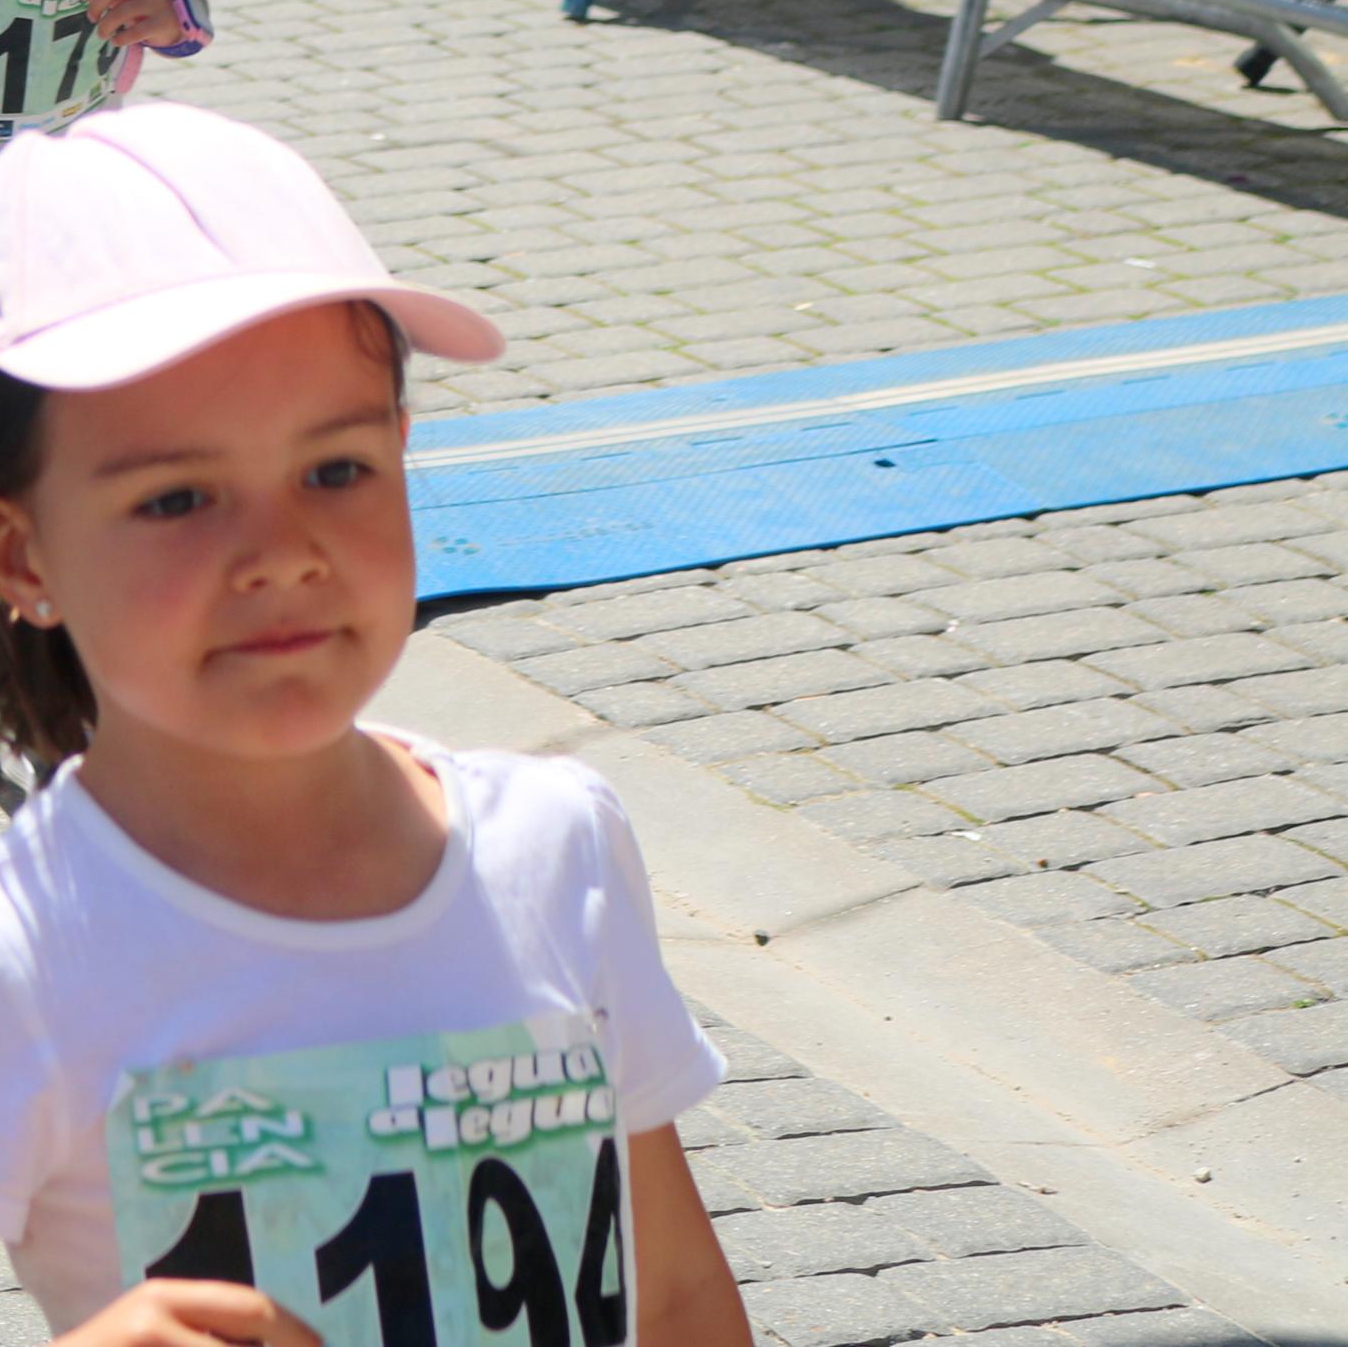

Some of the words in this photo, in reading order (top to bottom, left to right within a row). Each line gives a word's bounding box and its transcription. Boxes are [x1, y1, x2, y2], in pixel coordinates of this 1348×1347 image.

[386, 1044, 605, 1103] legua
[134, 1087, 273, 1122] PA
[138, 1109, 304, 1152] LEN
[141, 1143, 314, 1184] CIA
